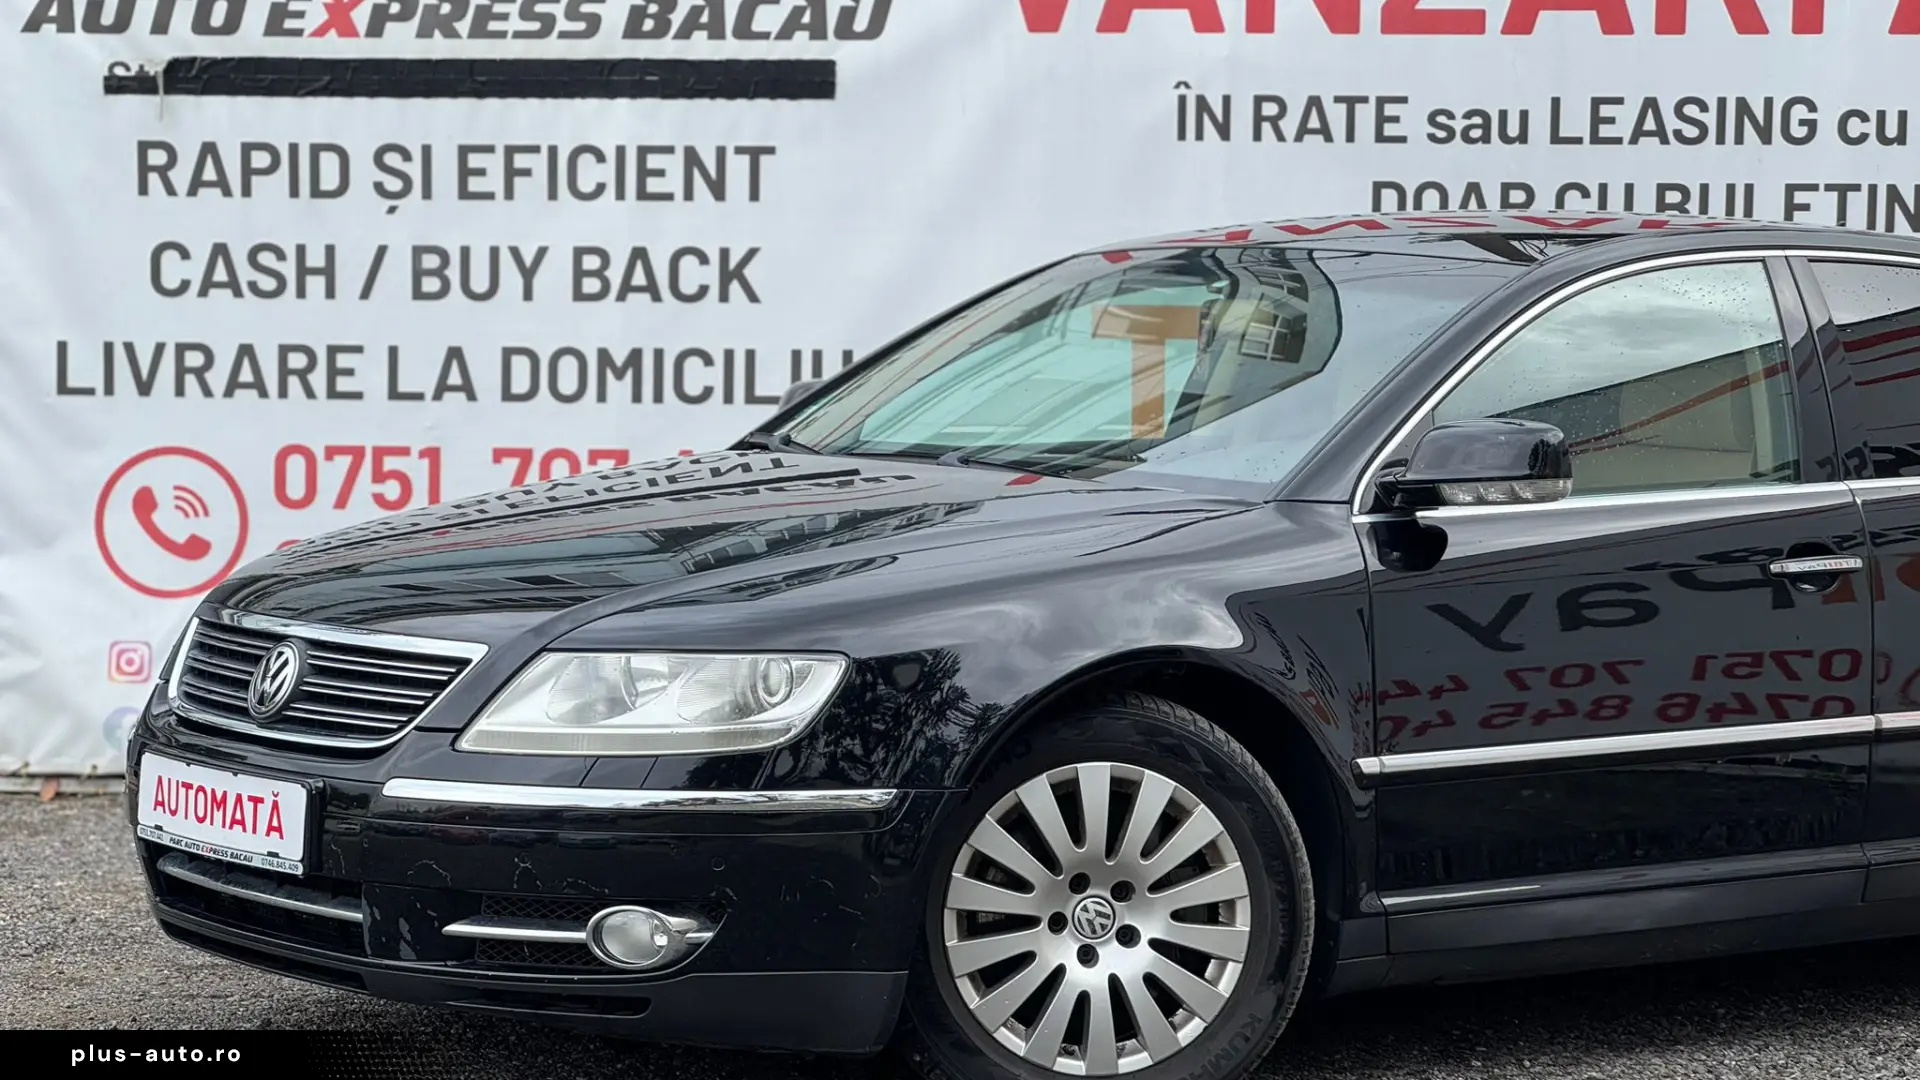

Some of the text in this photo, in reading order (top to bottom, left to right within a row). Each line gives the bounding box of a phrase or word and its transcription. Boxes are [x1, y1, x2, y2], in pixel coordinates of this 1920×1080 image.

[262, 0, 604, 39] EXPRESS
[1174, 80, 1909, 147] ÎN RATE sau LEASING cu
[136, 139, 351, 200] RAPID
[456, 144, 776, 203] EFICIENT
[150, 241, 762, 303] CASH / BUY BACK
[56, 340, 364, 400] LIVRARE
[387, 344, 478, 402] LA
[272, 443, 442, 512] 0751
[152, 774, 285, 841] AUTOMATĂ
[169, 836, 183, 847] PARC
[184, 841, 200, 851] AUTO
[201, 845, 229, 858] EXPRESS
